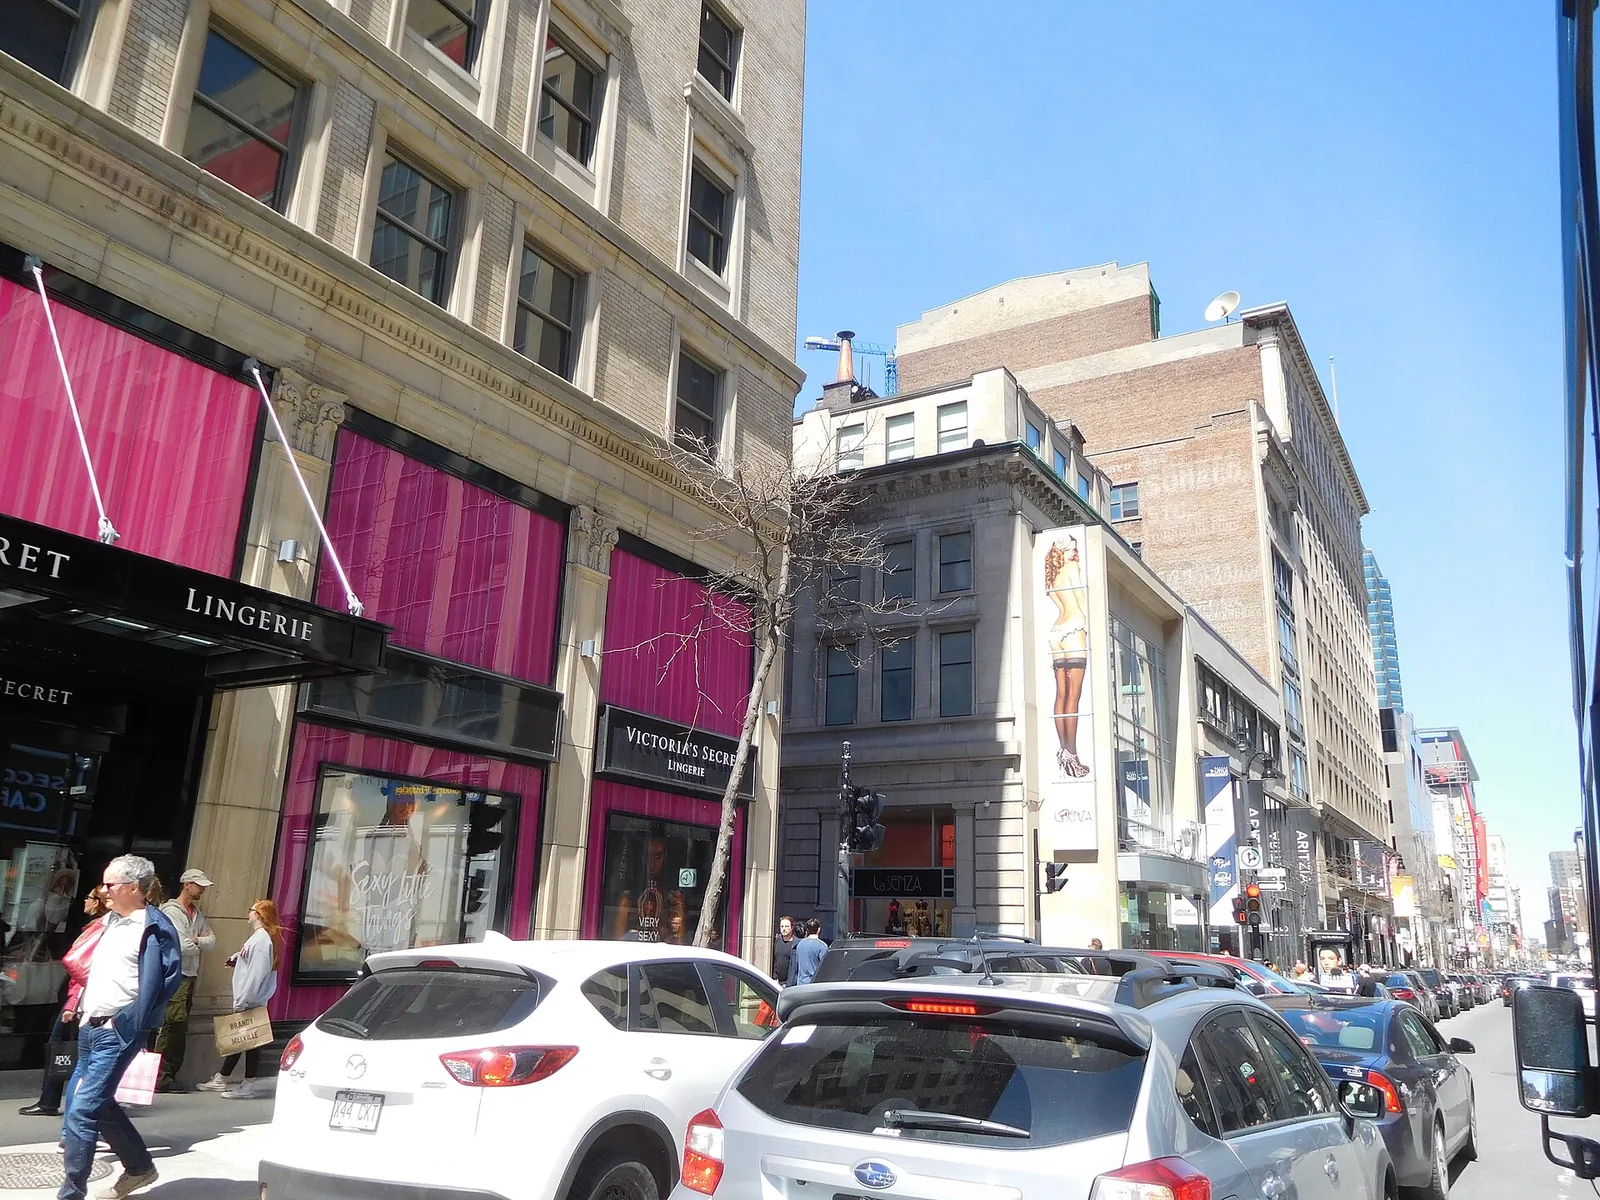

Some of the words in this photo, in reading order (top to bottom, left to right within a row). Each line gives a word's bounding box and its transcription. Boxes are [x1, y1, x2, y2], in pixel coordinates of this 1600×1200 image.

[185, 587, 313, 641] LINGERIE
[0, 677, 73, 705] ECRET
[626, 726, 699, 758] VICTORIA'S
[702, 745, 737, 767] SECRE
[668, 759, 705, 777] LINGERIE
[638, 916, 660, 927] VERY
[638, 931, 659, 941] SEXY
[229, 1018, 254, 1031] BRANDY
[231, 1030, 259, 1046] MELVILLE
